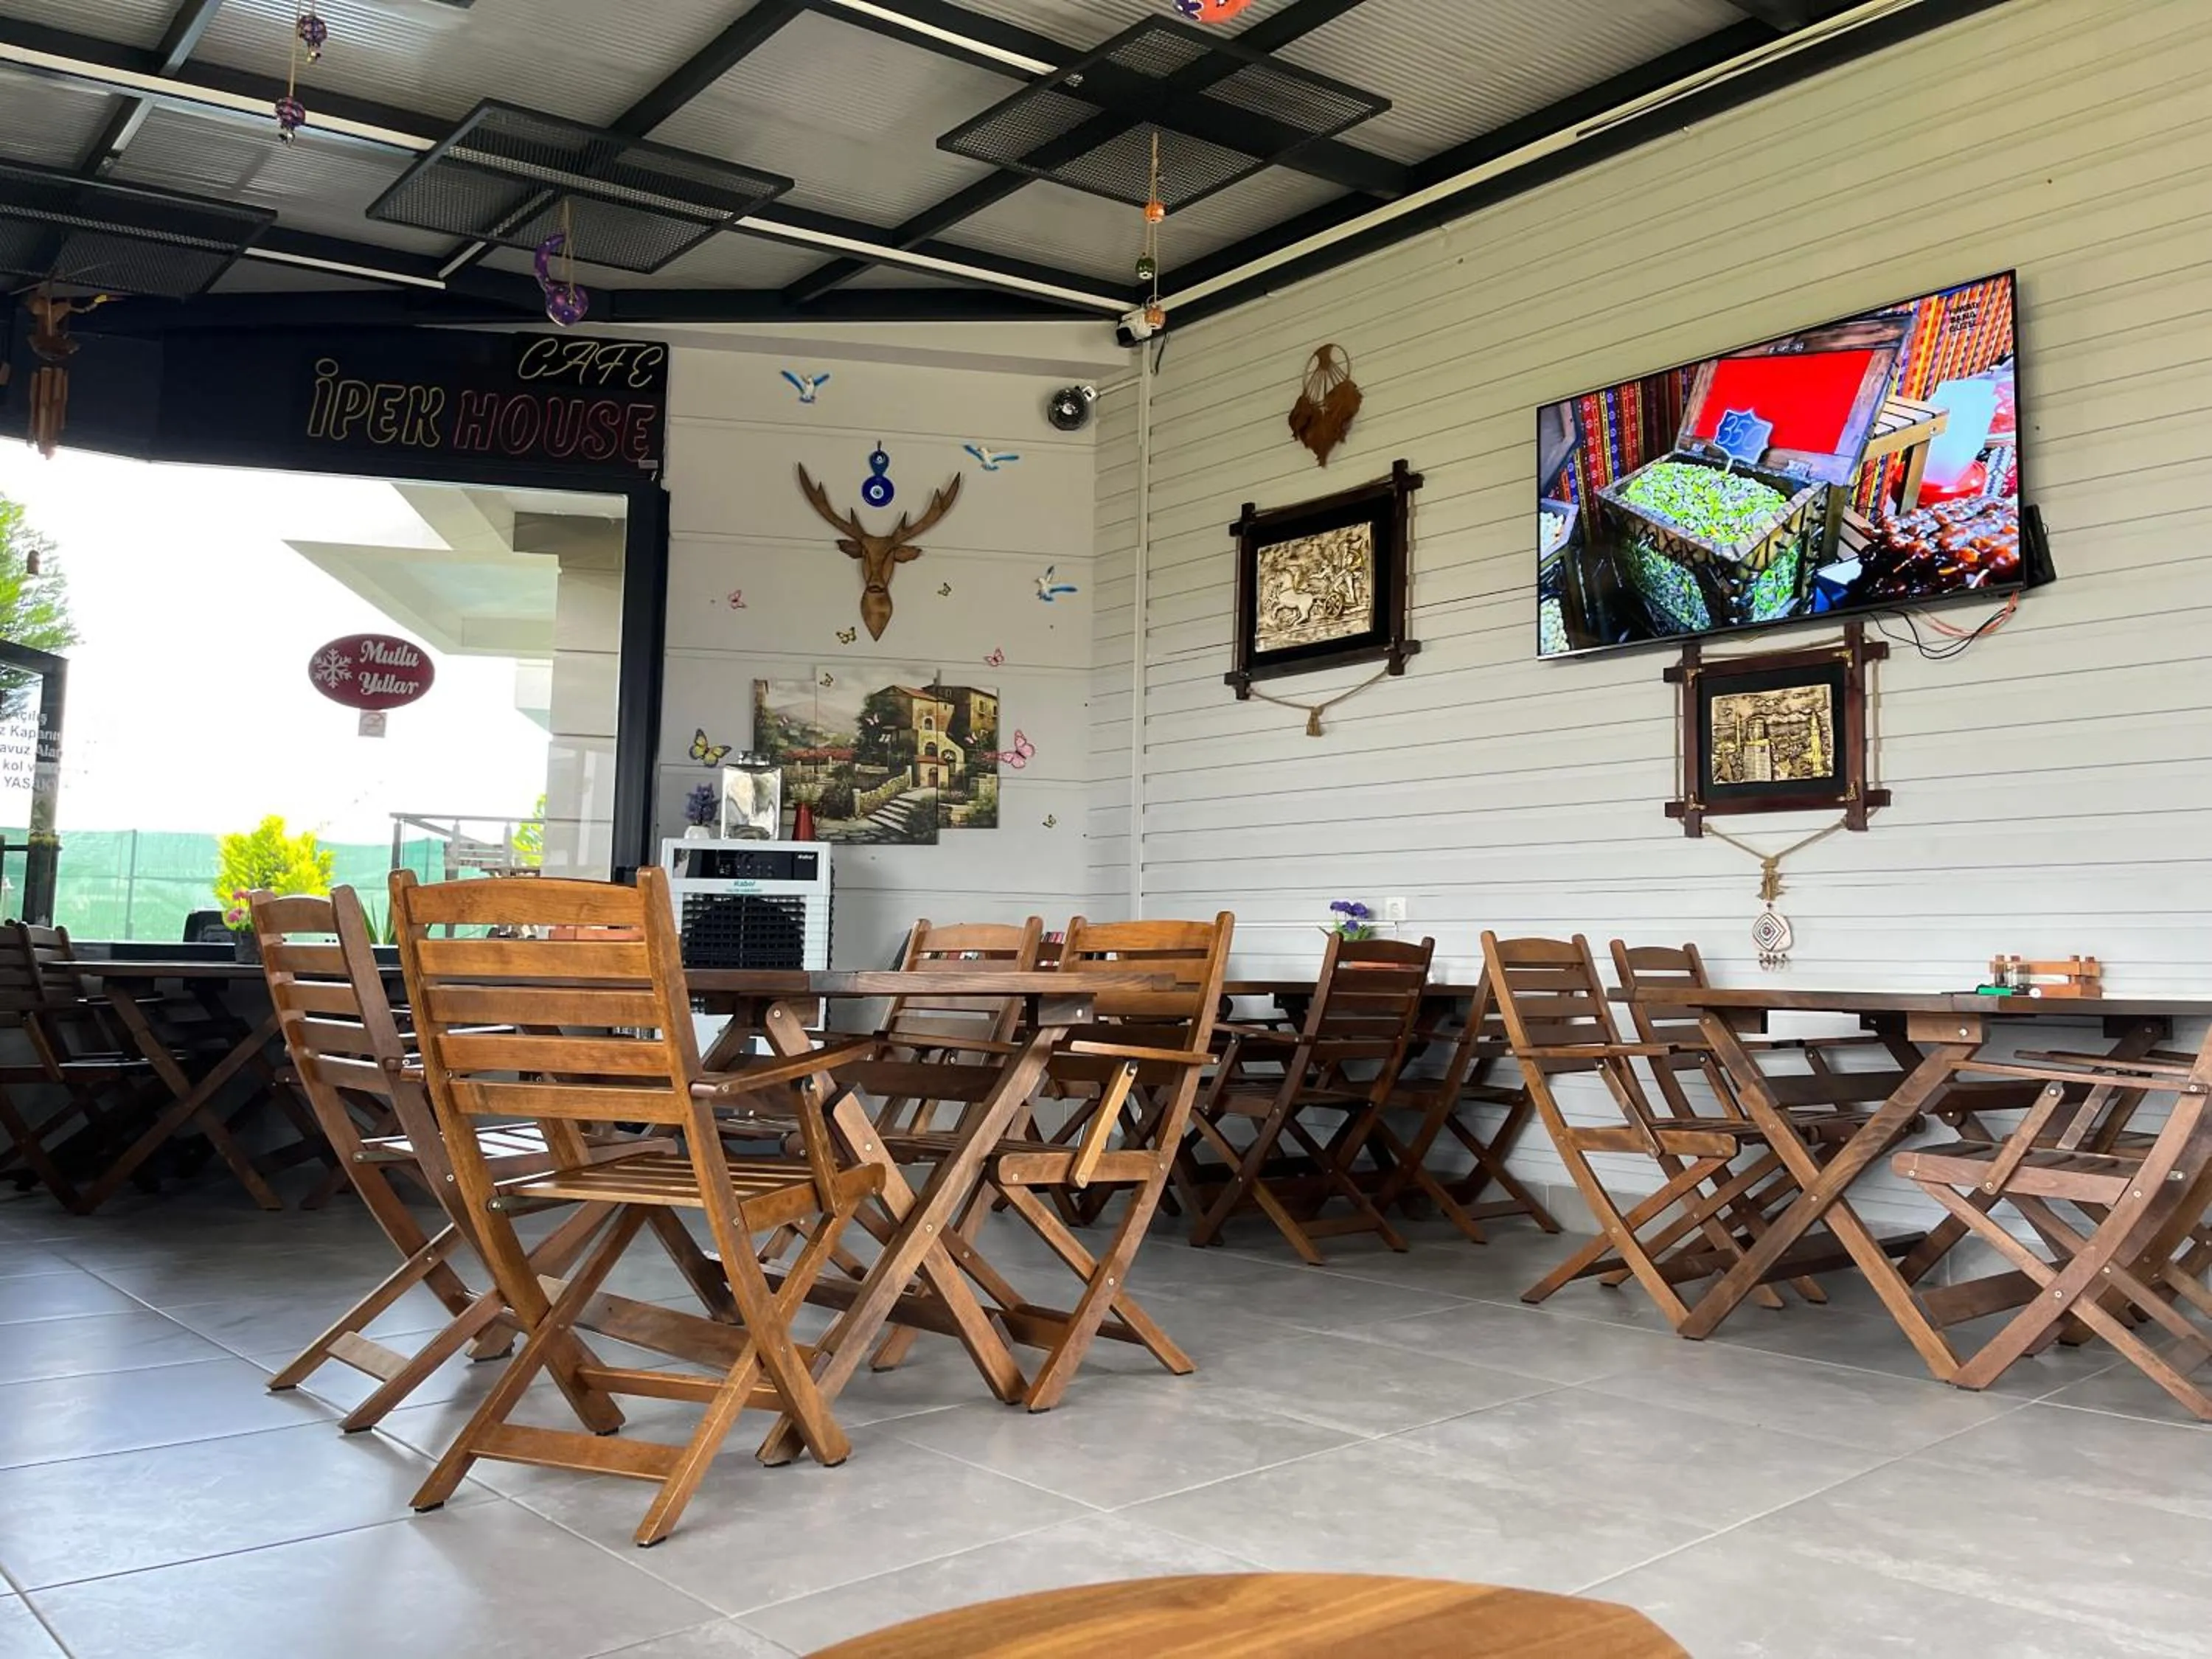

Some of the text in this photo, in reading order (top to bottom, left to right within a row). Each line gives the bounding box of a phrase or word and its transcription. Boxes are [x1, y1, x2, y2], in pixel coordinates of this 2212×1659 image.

[518, 338, 664, 388] CAFE
[453, 389, 657, 462] HOUSE
[1718, 415, 1764, 451] 350
[359, 640, 420, 667] Mutlu
[358, 672, 419, 695] Yıllar
[3, 758, 23, 771] kol
